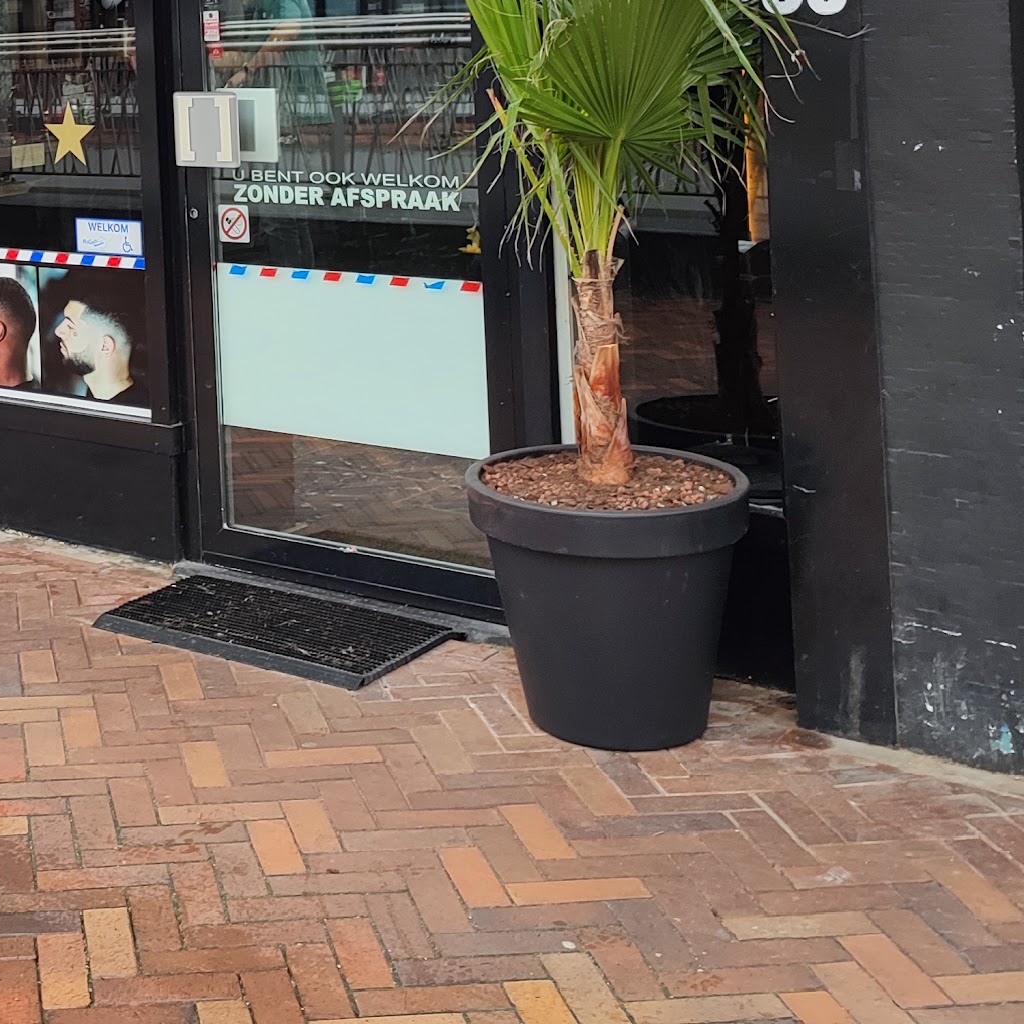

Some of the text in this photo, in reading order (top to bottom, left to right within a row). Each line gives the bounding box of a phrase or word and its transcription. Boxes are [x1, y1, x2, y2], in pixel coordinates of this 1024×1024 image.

[232, 169, 460, 189] U BENT OOK WELKOM
[233, 183, 461, 212] ZONDER AFSPRAAK
[87, 221, 129, 233] WELKOM
